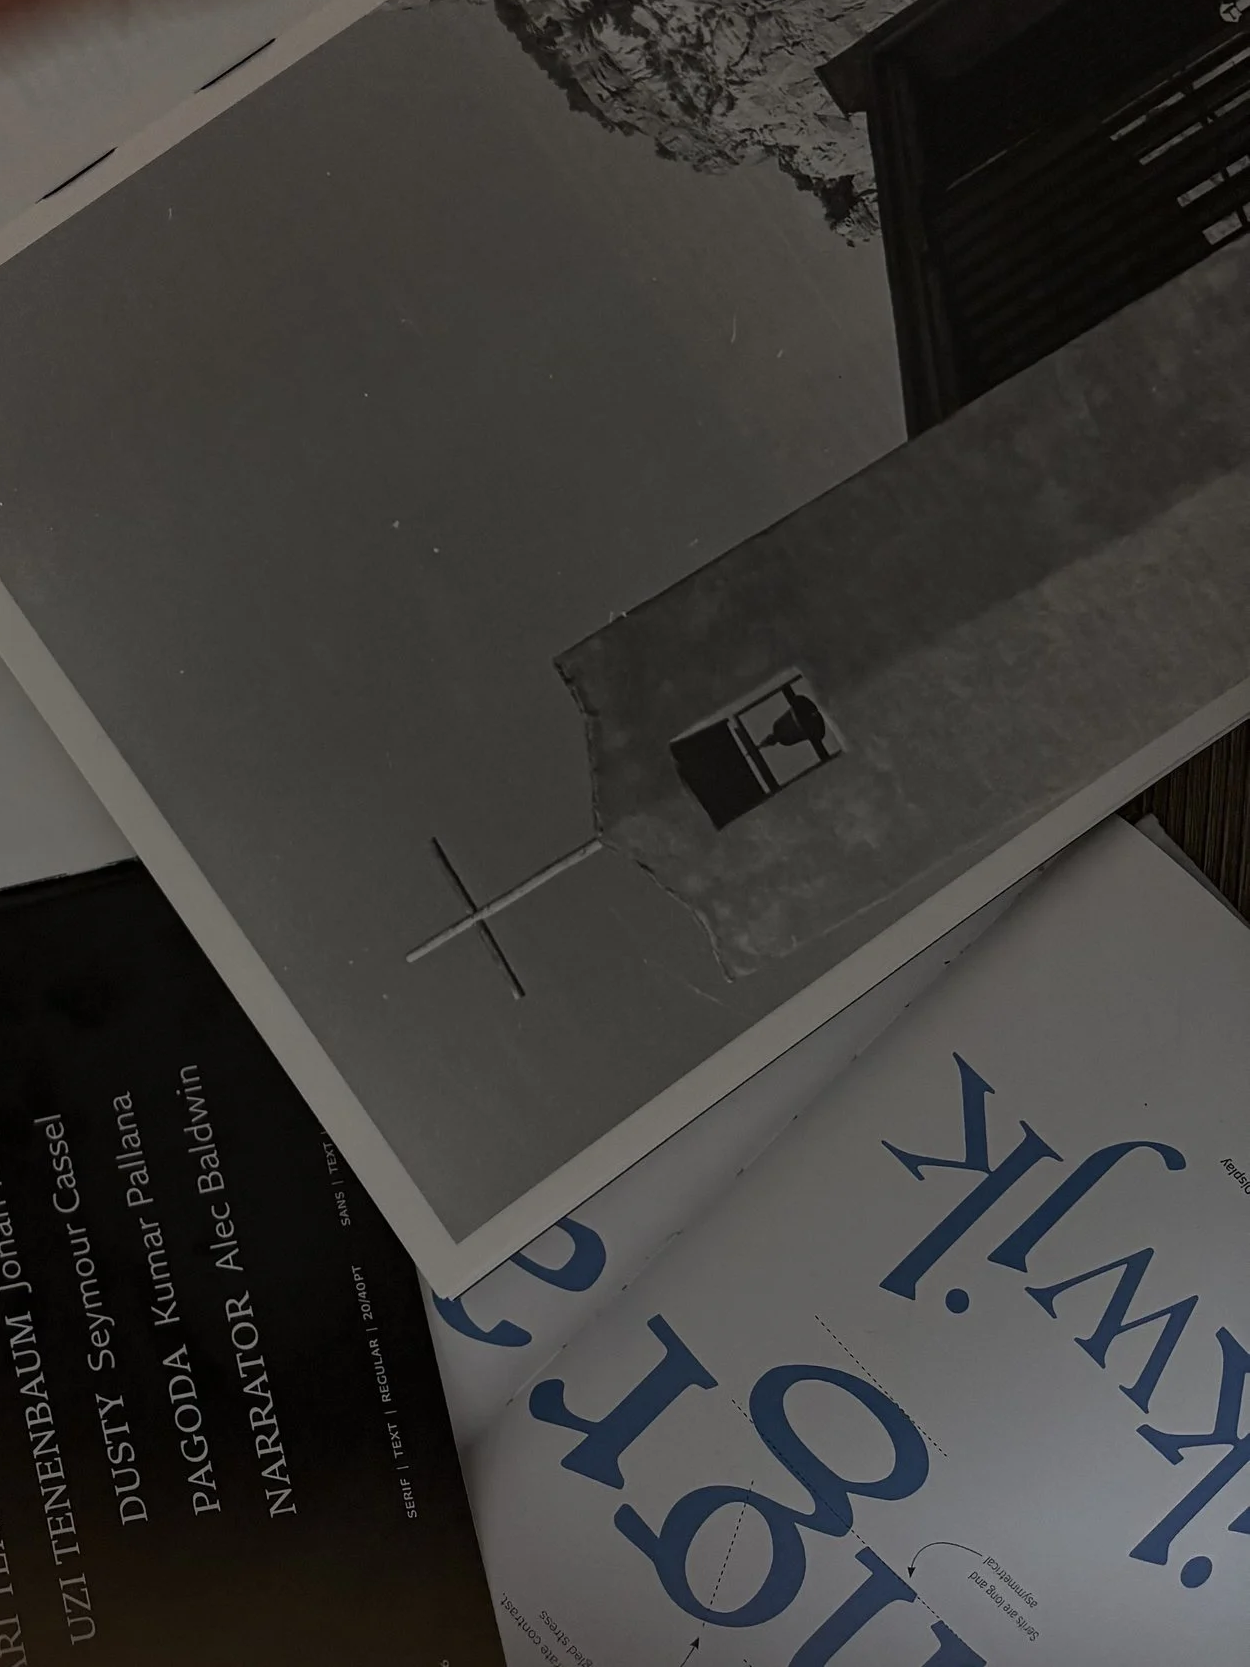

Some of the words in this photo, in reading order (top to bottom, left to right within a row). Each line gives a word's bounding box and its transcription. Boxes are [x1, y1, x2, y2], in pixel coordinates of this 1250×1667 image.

[33, 1113, 80, 1213] Cassel
[112, 1090, 154, 1207] Pallana
[180, 1064, 225, 1194] Baldwin
[139, 1217, 180, 1326] Kumar
[209, 1201, 244, 1271] Alec
[66, 1223, 115, 1371] Seymour
[351, 1265, 373, 1320] 20/40PT
[225, 1289, 297, 1518] NARRATOR
[368, 1338, 391, 1402] REGULAR
[4, 1310, 80, 1565] TENENBAUM
[94, 1393, 148, 1526] DUSTY
[162, 1343, 221, 1516] PAGODA
[387, 1422, 403, 1459] TEXT
[399, 1478, 417, 1518] SERIF
[58, 1573, 95, 1645] UZI
[967, 1571, 988, 1589] and
[982, 1555, 1038, 1608] asymmetrical
[985, 1584, 1005, 1608] long
[1002, 1603, 1018, 1618] are
[1015, 1615, 1039, 1642] Serifs
